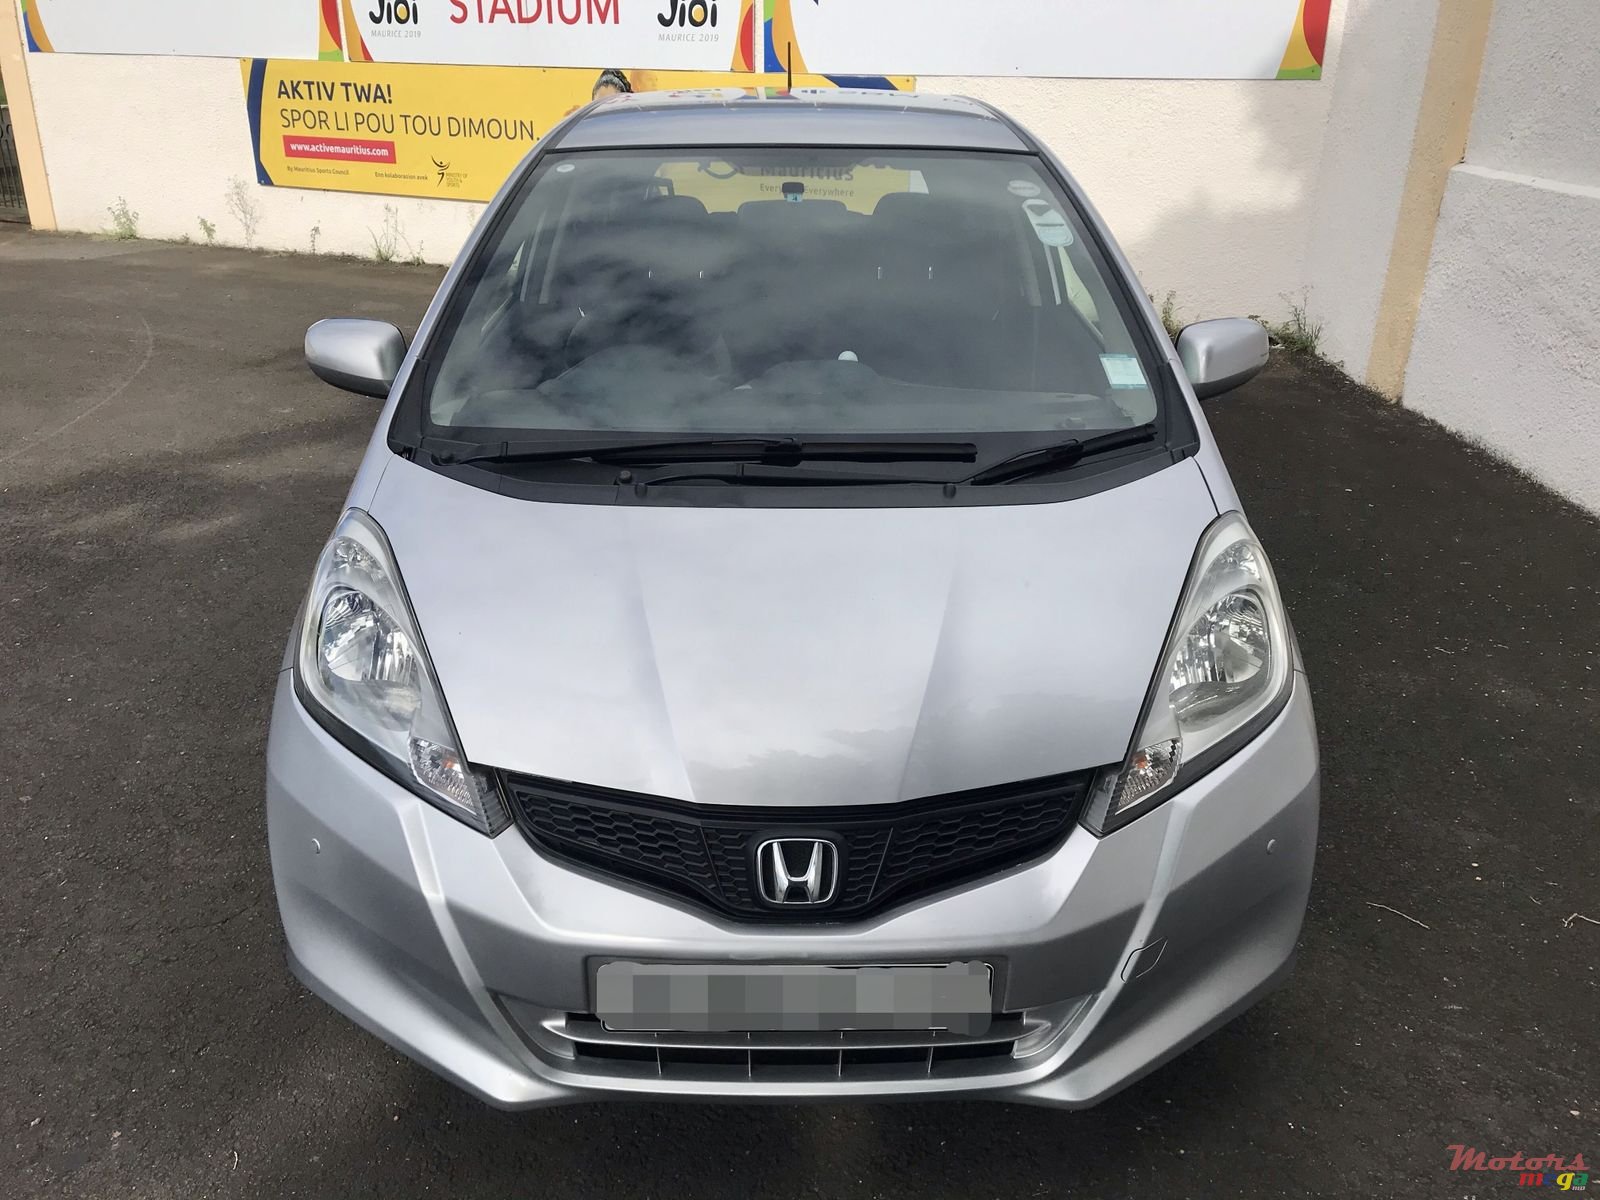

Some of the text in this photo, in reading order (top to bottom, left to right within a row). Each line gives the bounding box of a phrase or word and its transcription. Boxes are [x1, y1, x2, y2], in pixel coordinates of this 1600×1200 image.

[371, 30, 401, 38] MAURICE
[658, 33, 719, 42] MAURICE 2019
[277, 79, 393, 104] AKTIV TWA!
[280, 108, 541, 141] SPOR LI POU TOU DIMOUN.
[290, 143, 389, 156] www.activemauritius.com
